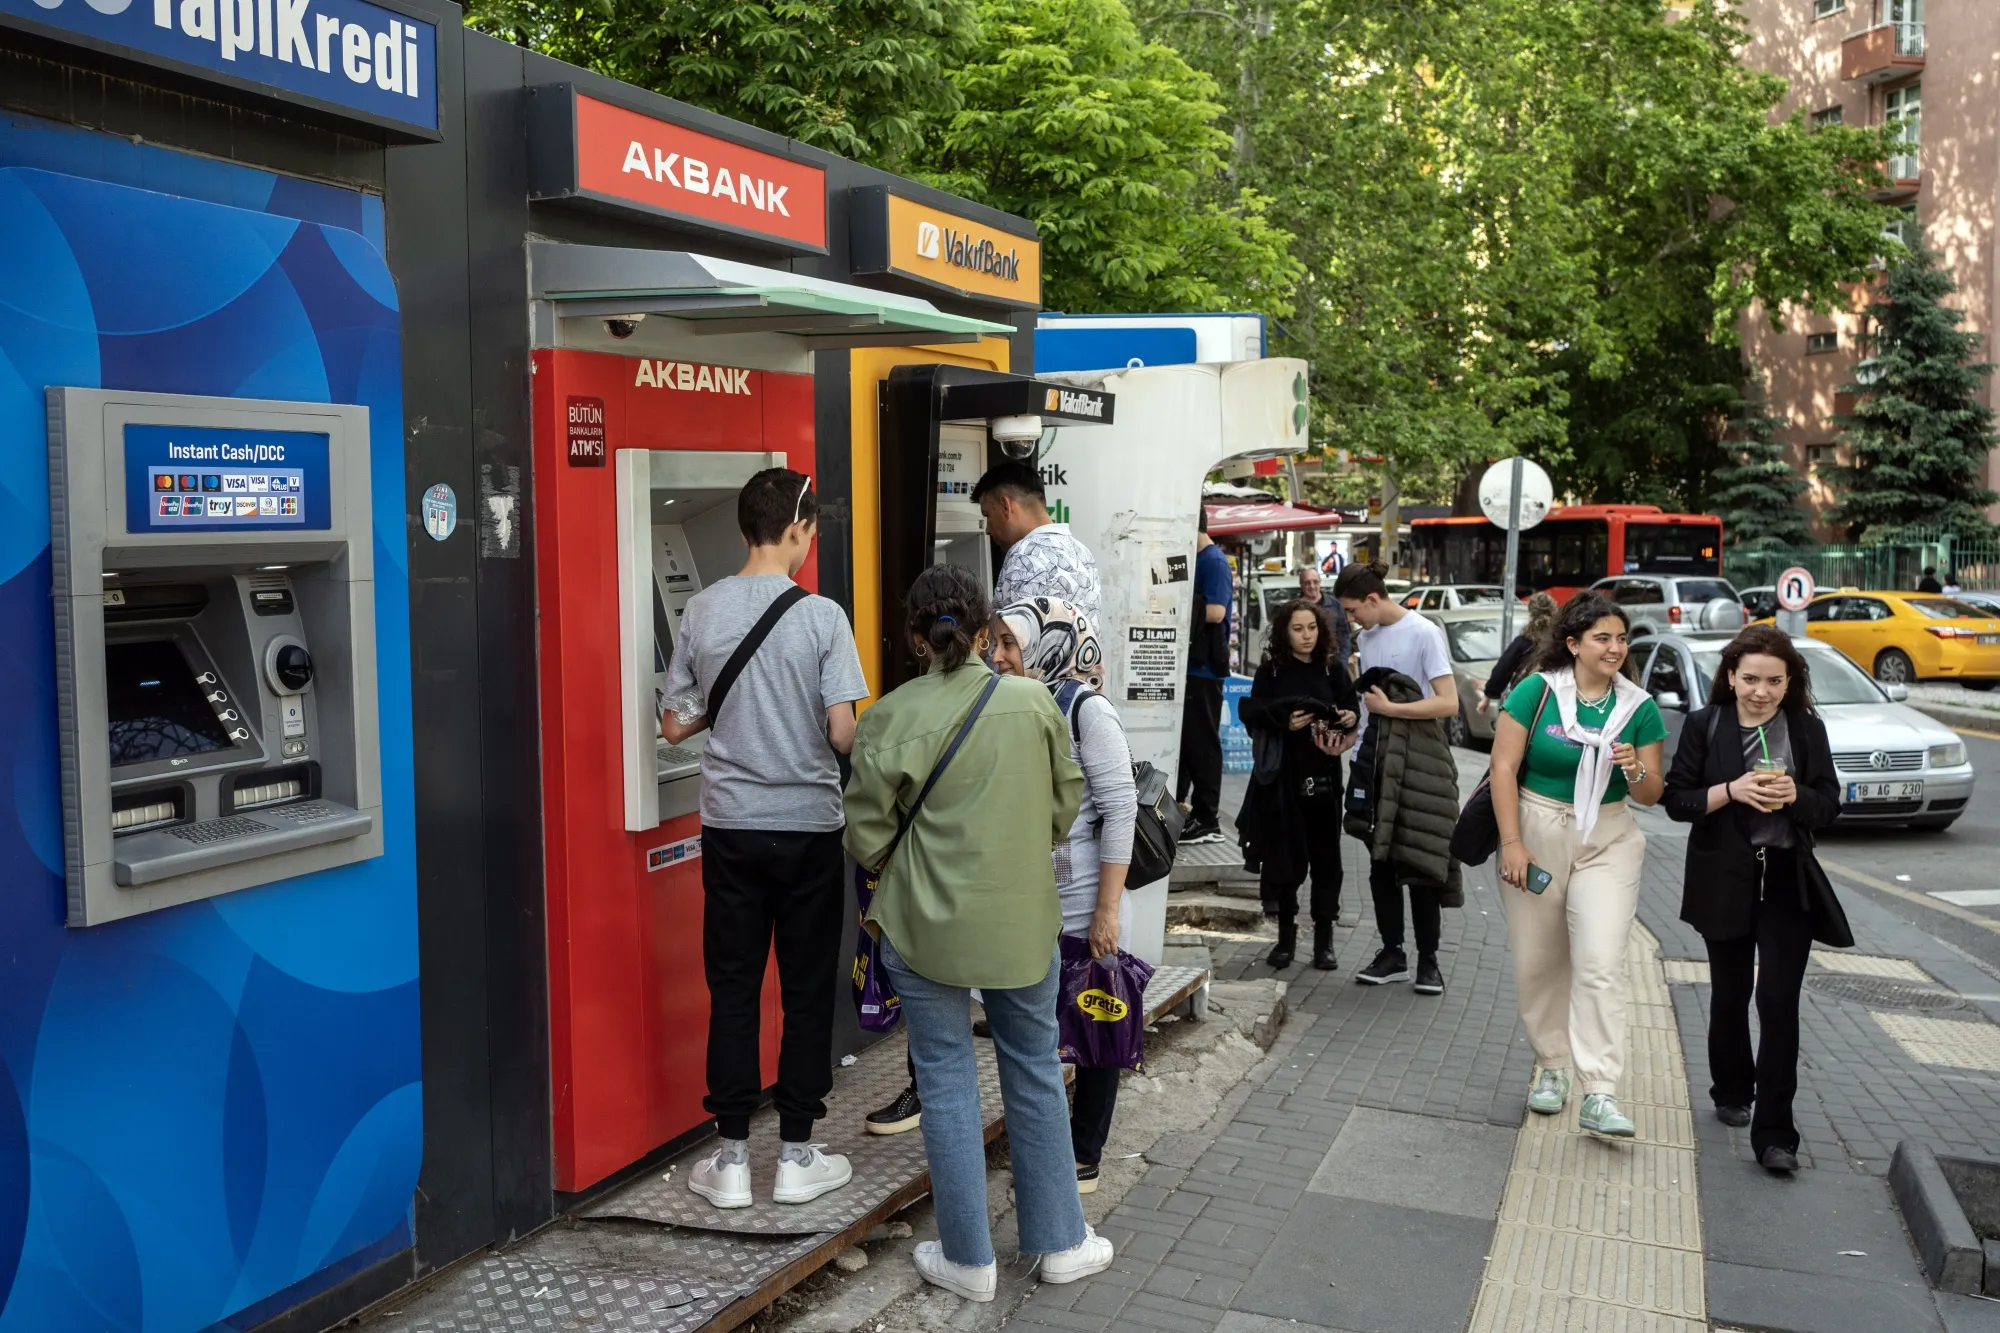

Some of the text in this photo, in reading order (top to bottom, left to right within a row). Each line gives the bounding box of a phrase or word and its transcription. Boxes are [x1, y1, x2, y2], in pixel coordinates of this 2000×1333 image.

[622, 141, 790, 217] AKBANK
[942, 227, 1020, 282] VakıfBank
[635, 359, 752, 395] AKBANK
[568, 402, 602, 424] BÜTÜN
[1059, 390, 1104, 417] VakıfBank
[569, 426, 603, 436] BANKALARIN
[169, 442, 285, 463] Instant Cash/DCC
[571, 436, 604, 456] ATM'Sİ
[225, 478, 246, 489] VISA
[250, 476, 266, 485] VISA
[1038, 463, 1068, 486] tik
[209, 499, 231, 514] troy
[281, 502, 296, 510] JCB
[1132, 628, 1176, 641] İŞ İLANI
[1857, 783, 1921, 797] 18 AG 230
[1082, 993, 1123, 1014] gratis
